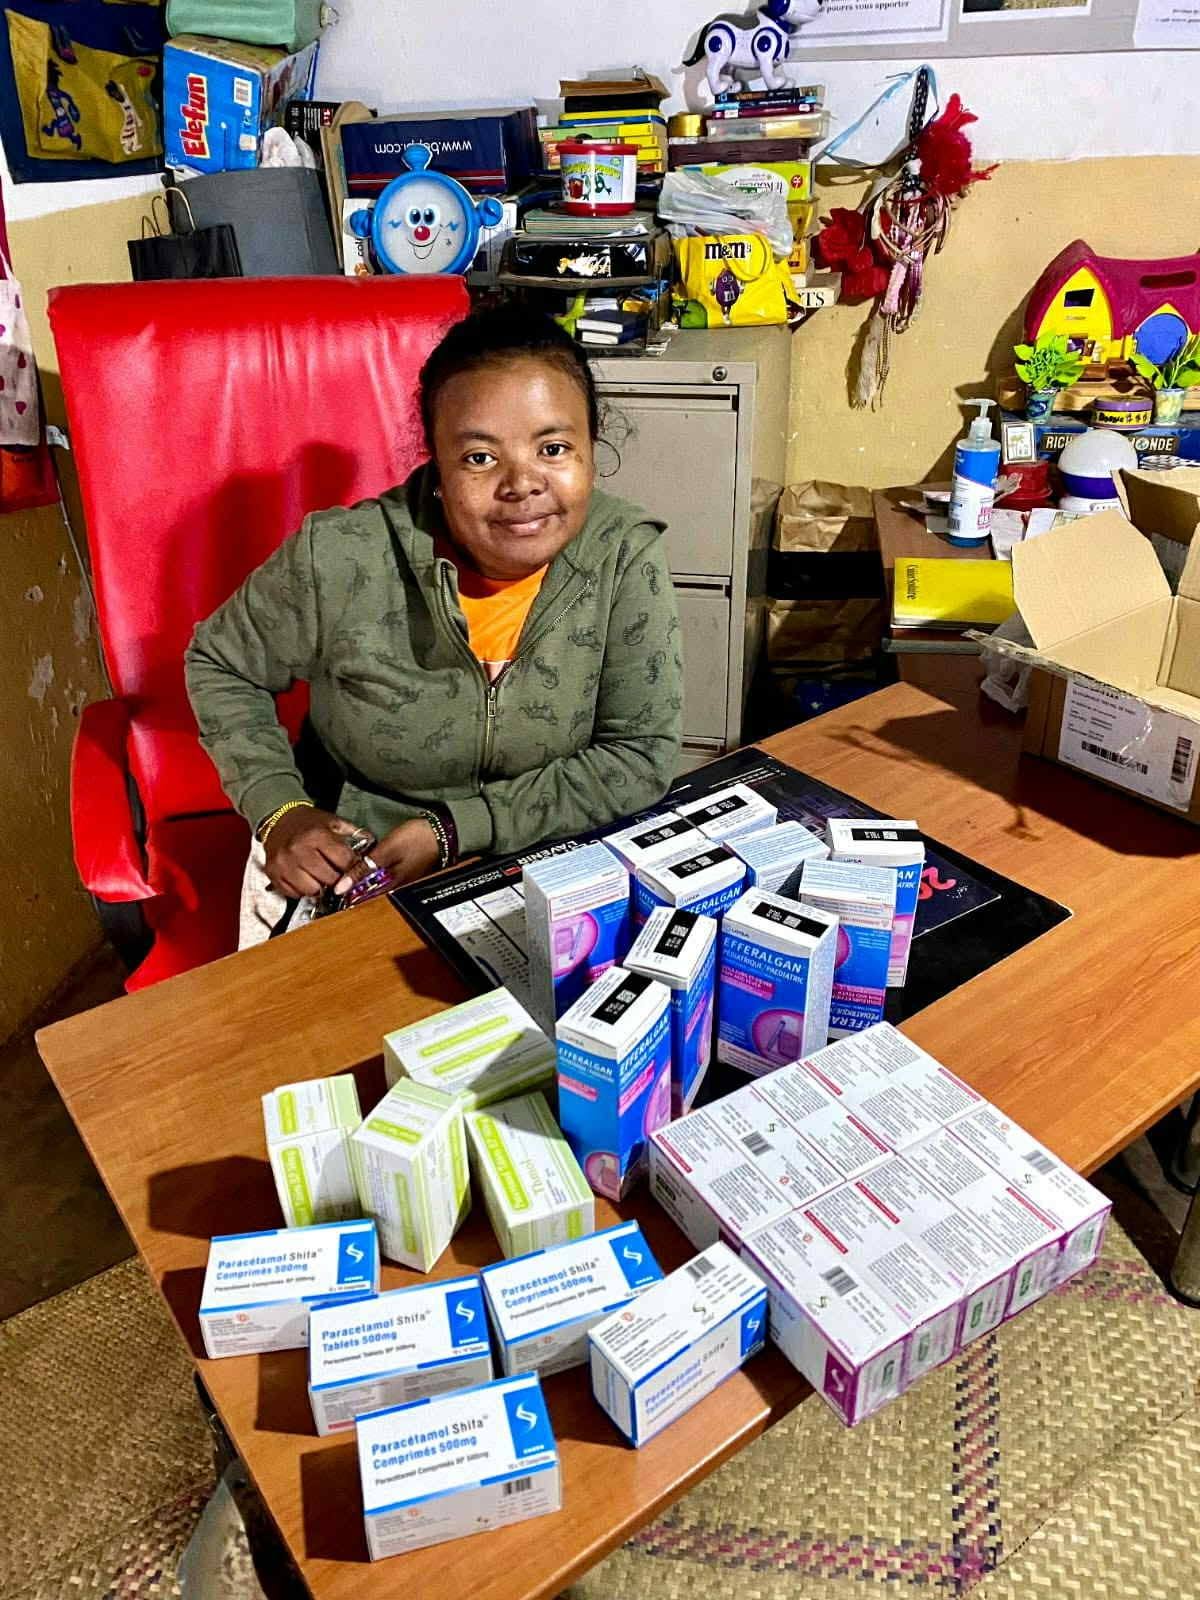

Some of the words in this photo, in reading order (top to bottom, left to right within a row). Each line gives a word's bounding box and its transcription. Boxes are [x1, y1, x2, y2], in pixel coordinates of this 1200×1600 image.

[181, 75, 208, 157] Elefun
[1045, 436, 1073, 450] RICH
[723, 939, 802, 973] EFFERALGAN
[832, 1016, 870, 1029] FFERA
[559, 1047, 613, 1075] EFFERALGAN
[216, 1266, 272, 1281] Comprimés
[274, 1262, 308, 1274] 500mg
[218, 1251, 287, 1270] Paracétamol
[501, 1268, 568, 1298] Paracétamol
[504, 1284, 560, 1309] Comprimés
[560, 1273, 594, 1290] 500mg
[322, 1318, 394, 1341] Paracetamol
[322, 1337, 360, 1352] Tablets
[362, 1330, 397, 1345] 500mg
[371, 1427, 449, 1456] Paracétamol
[373, 1444, 437, 1471] Comprimés
[438, 1434, 478, 1454] 500mg
